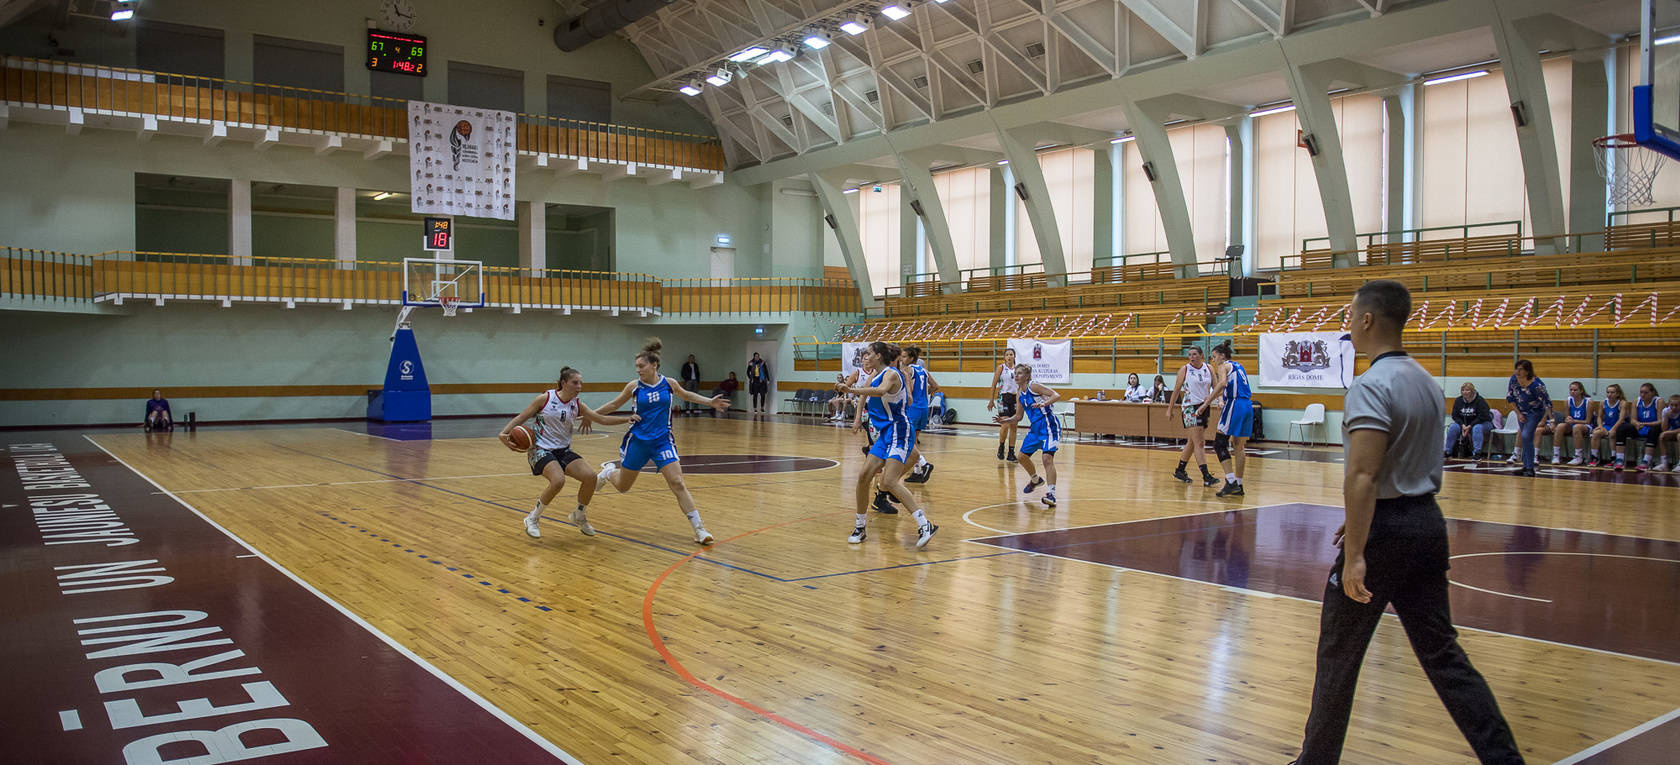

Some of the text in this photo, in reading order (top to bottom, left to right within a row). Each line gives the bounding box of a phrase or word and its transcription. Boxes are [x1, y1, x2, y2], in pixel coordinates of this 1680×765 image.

[371, 41, 384, 51] 67
[394, 46, 401, 54] 4
[410, 46, 423, 57] 69
[371, 57, 378, 67] 3
[416, 63, 423, 73] 2
[433, 232, 447, 247] 18
[646, 391, 660, 403] 10
[660, 449, 673, 460] 10
[54, 559, 175, 595] UN
